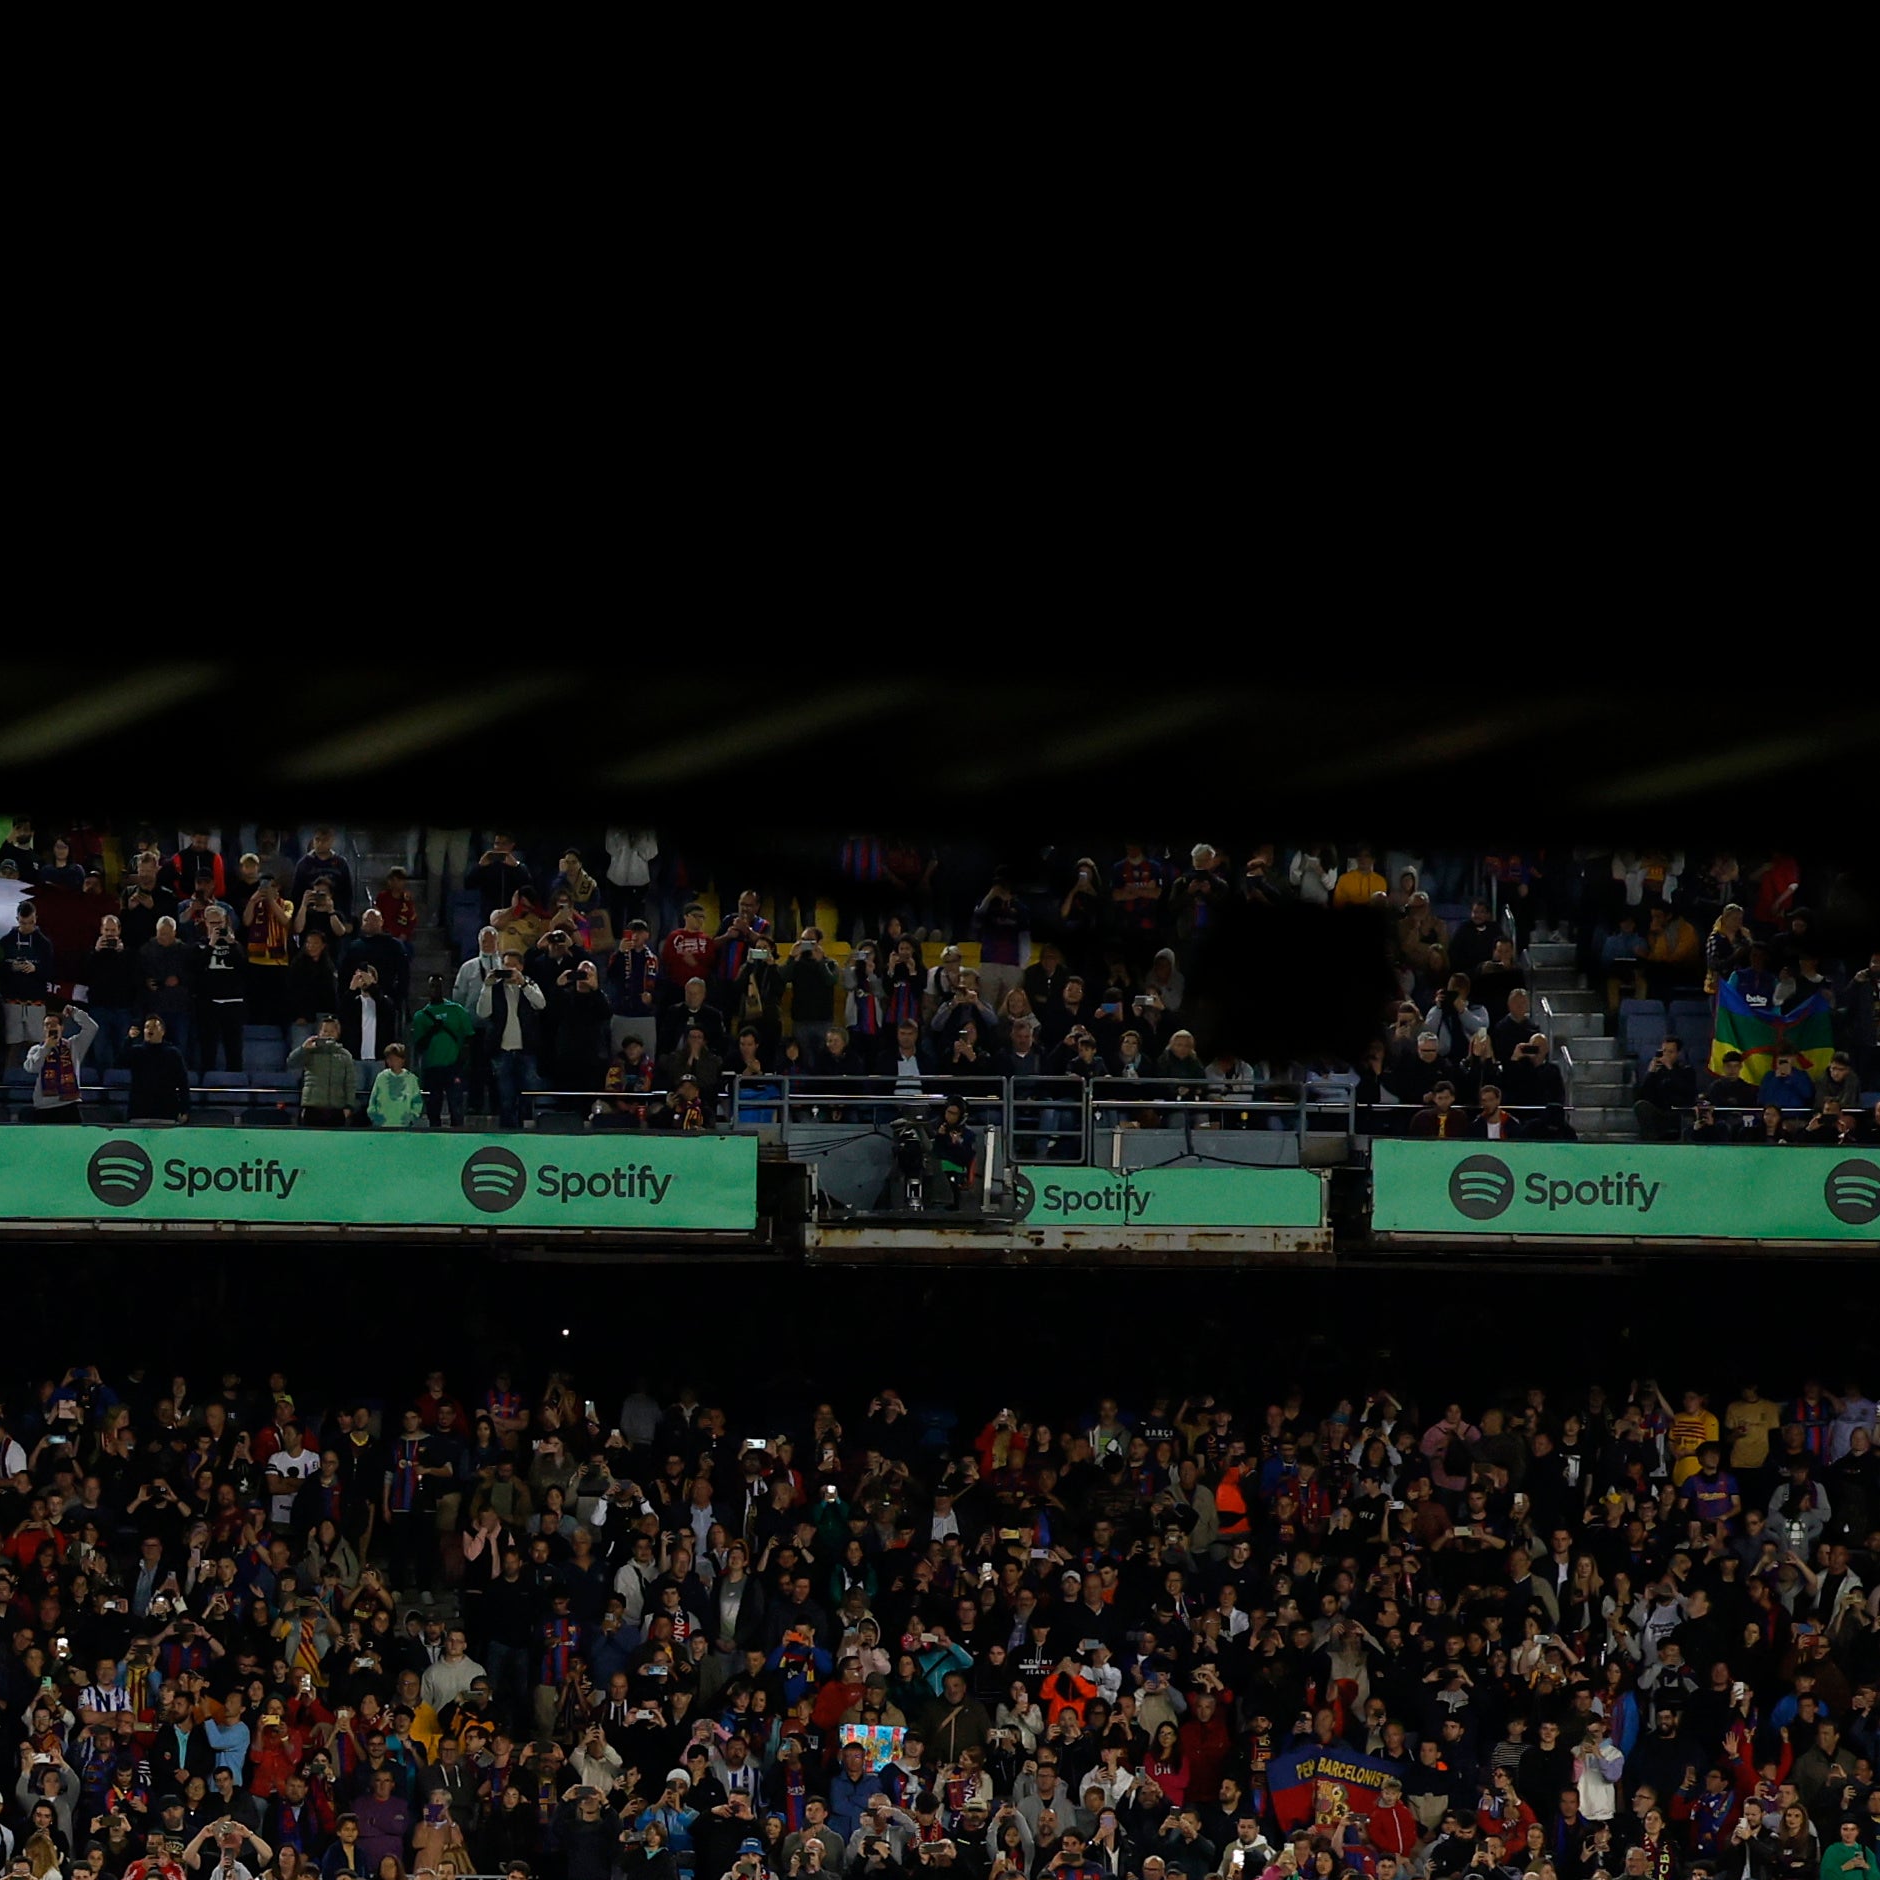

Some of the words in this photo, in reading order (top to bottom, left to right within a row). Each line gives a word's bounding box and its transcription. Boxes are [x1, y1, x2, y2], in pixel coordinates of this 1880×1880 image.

[163, 1153, 300, 1198] Spotify
[537, 1163, 673, 1205] Spotify
[1524, 1170, 1660, 1212] Spotify
[1043, 1178, 1150, 1216] Spotify
